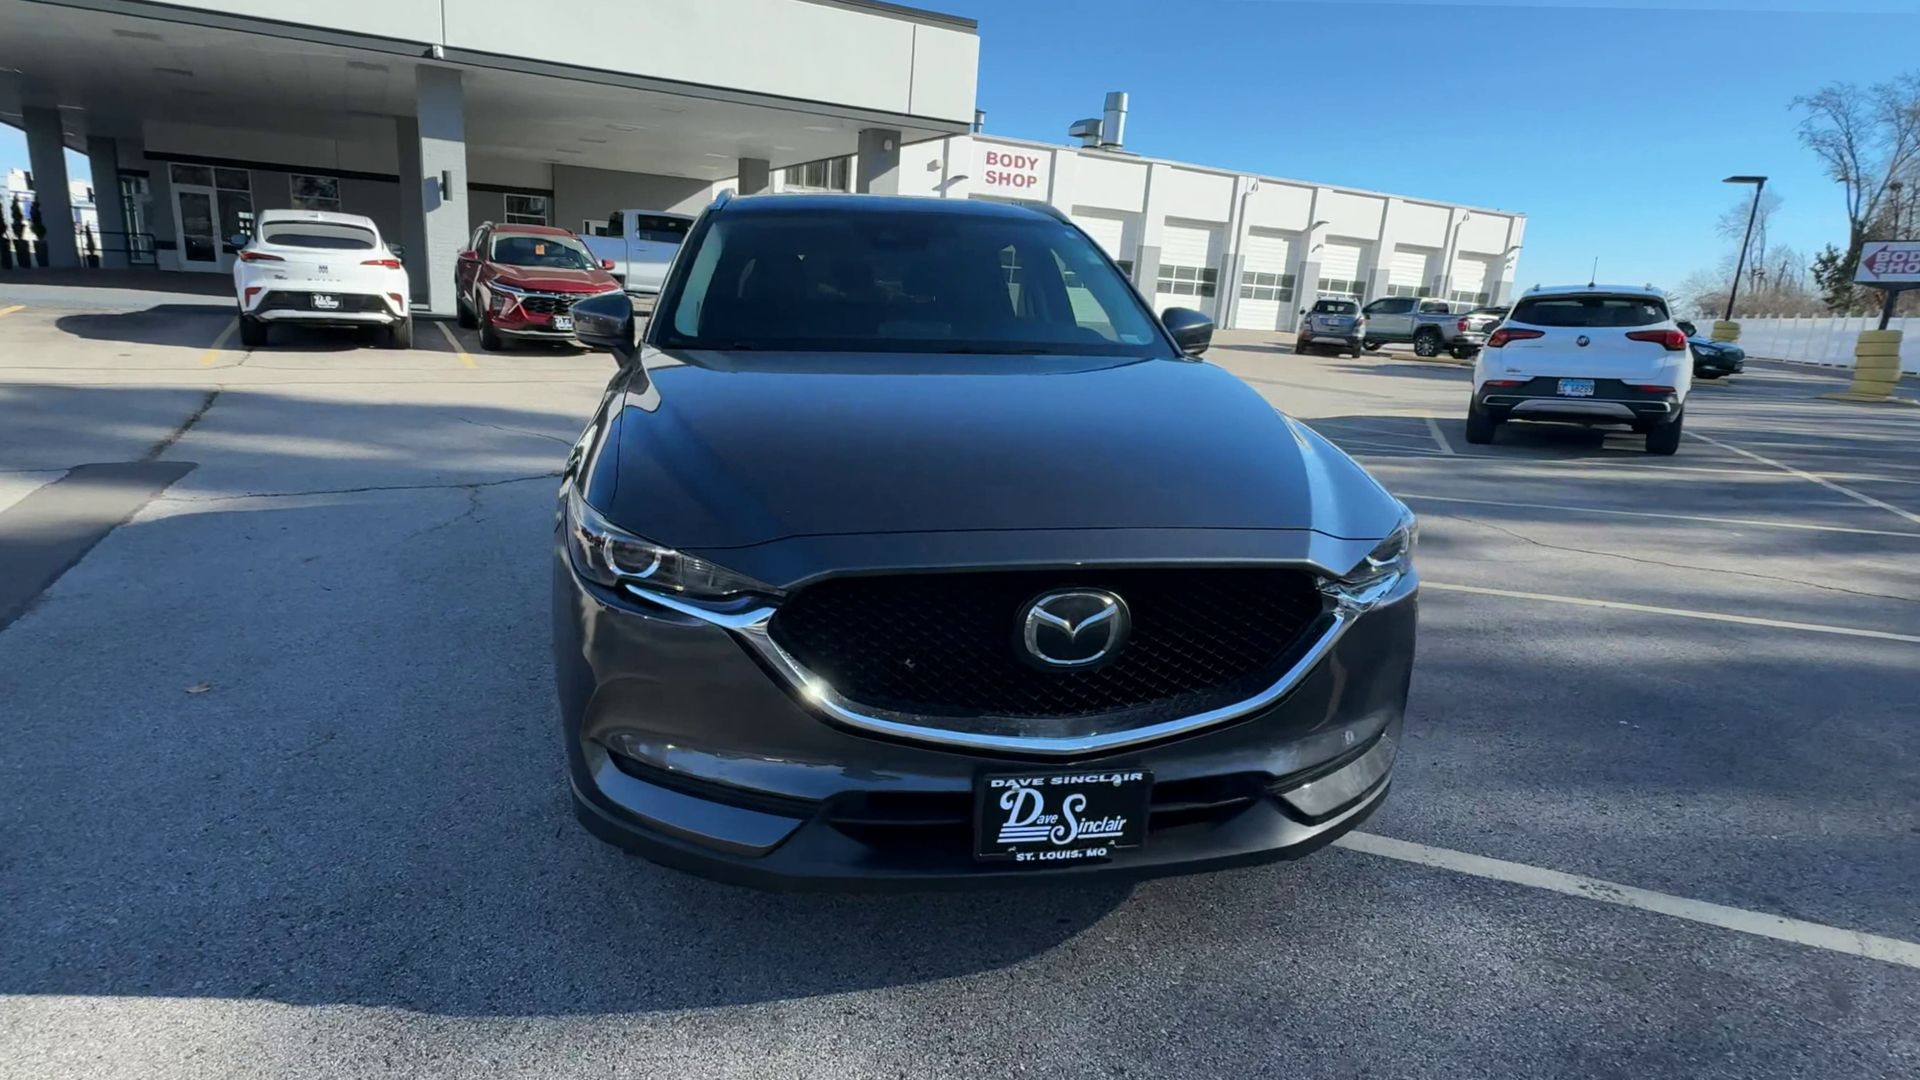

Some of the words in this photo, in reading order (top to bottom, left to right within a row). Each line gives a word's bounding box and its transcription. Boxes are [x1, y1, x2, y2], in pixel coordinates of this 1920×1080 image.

[986, 151, 1039, 171] BODY
[985, 170, 1037, 188] SHOP
[991, 778, 1044, 788] DAVE
[1050, 773, 1143, 785] SINCLAIR
[1000, 788, 1058, 826] Dave
[1051, 794, 1127, 845] Sinclair
[1016, 853, 1035, 861] ST.
[1086, 848, 1107, 857] MO
